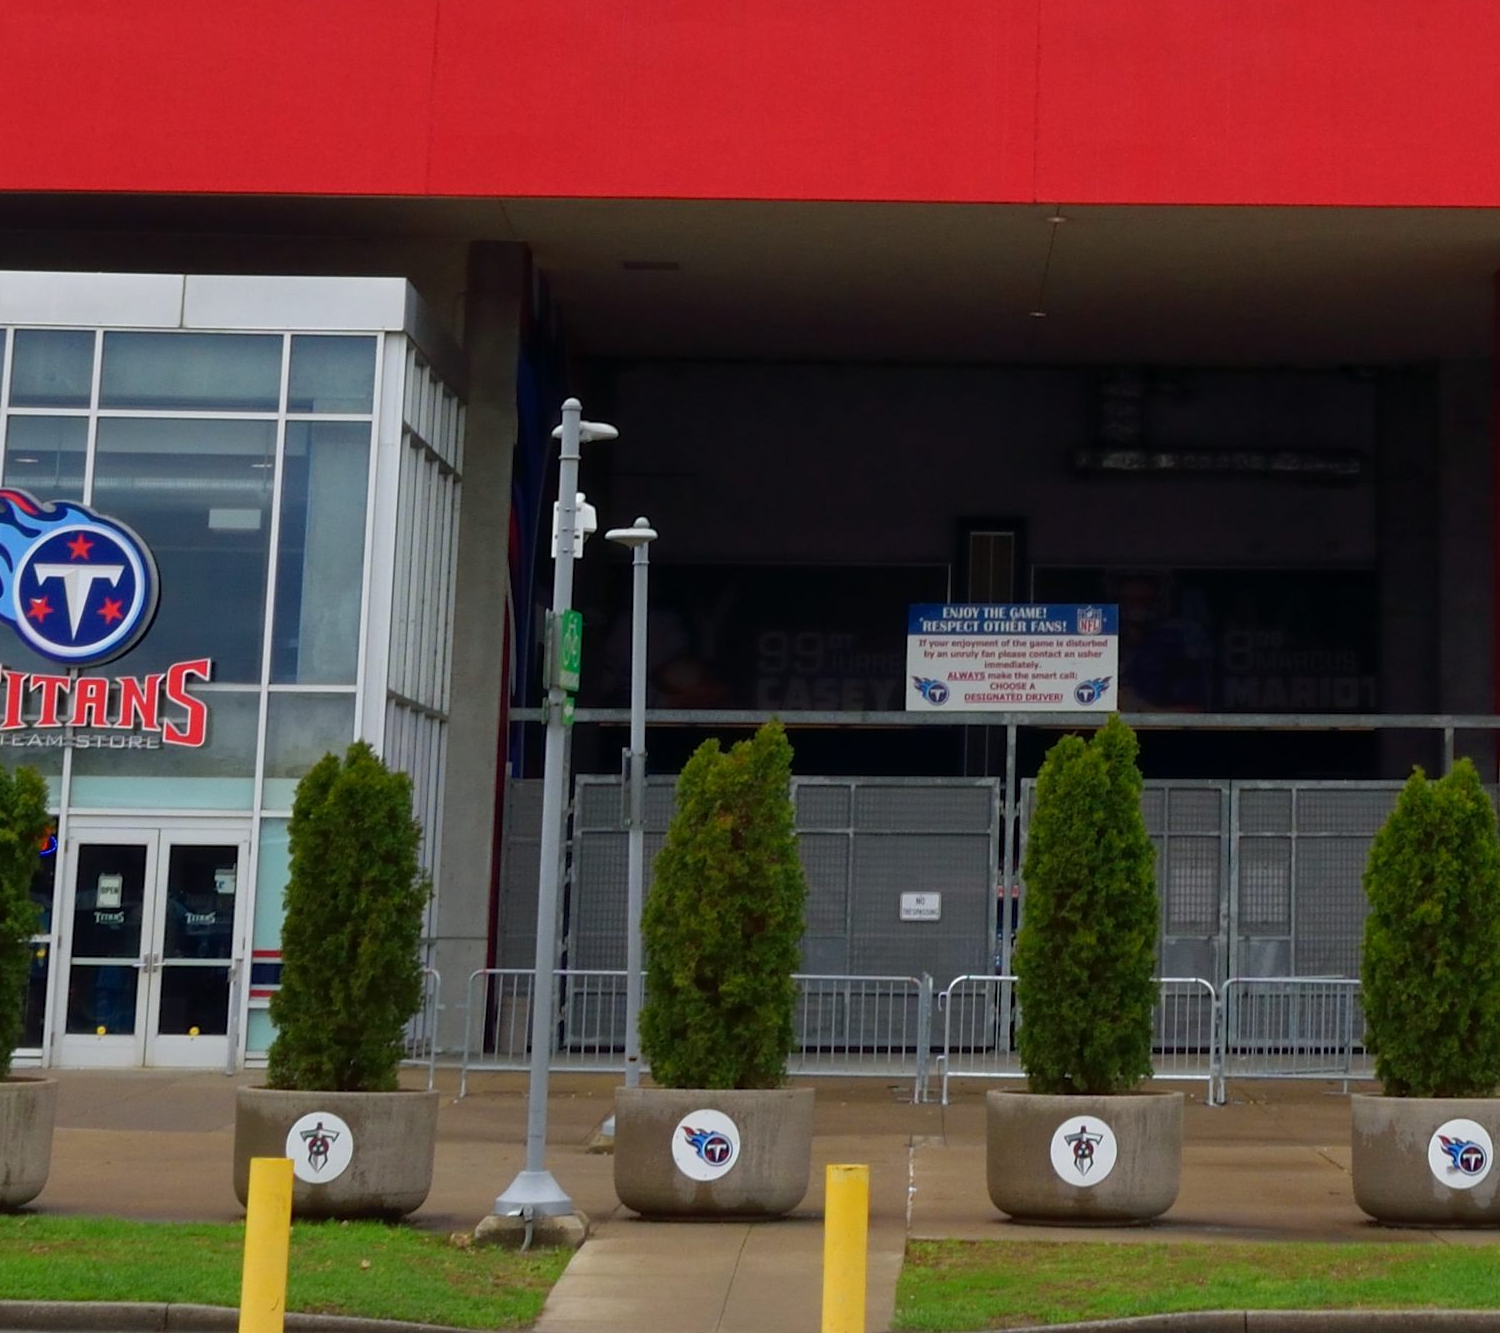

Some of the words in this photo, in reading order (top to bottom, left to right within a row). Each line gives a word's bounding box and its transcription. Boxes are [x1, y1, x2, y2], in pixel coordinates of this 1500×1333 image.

[942, 607, 979, 619] ENJOY
[983, 607, 1006, 619] THE
[1010, 607, 1047, 619] GAME!
[923, 621, 980, 632] RESPECT
[983, 621, 1027, 632] OTHER
[1031, 621, 1067, 632] FANS!
[1080, 619, 1099, 630] NFL
[929, 640, 949, 648] your
[951, 639, 998, 648] enjoyment
[1001, 639, 1011, 647] of
[1013, 639, 1027, 647] the
[1030, 640, 1054, 649] game
[1066, 639, 1108, 647] disturbed
[924, 650, 935, 659] by
[951, 650, 979, 659] unruly
[981, 650, 996, 658] fan
[998, 650, 1027, 659] please
[1029, 650, 1061, 658] contact
[1078, 650, 1103, 658] usher
[984, 661, 1042, 670] immediately.
[948, 672, 985, 681] ALWAYS
[990, 683, 1027, 691] CHOOSE
[1030, 683, 1036, 691] A
[756, 676, 897, 711] CASEY
[964, 693, 1023, 702] DESIGNATED
[1025, 693, 1063, 702] DRIVER!
[1223, 676, 1377, 709] MARIOT
[75, 733, 161, 750] STORE
